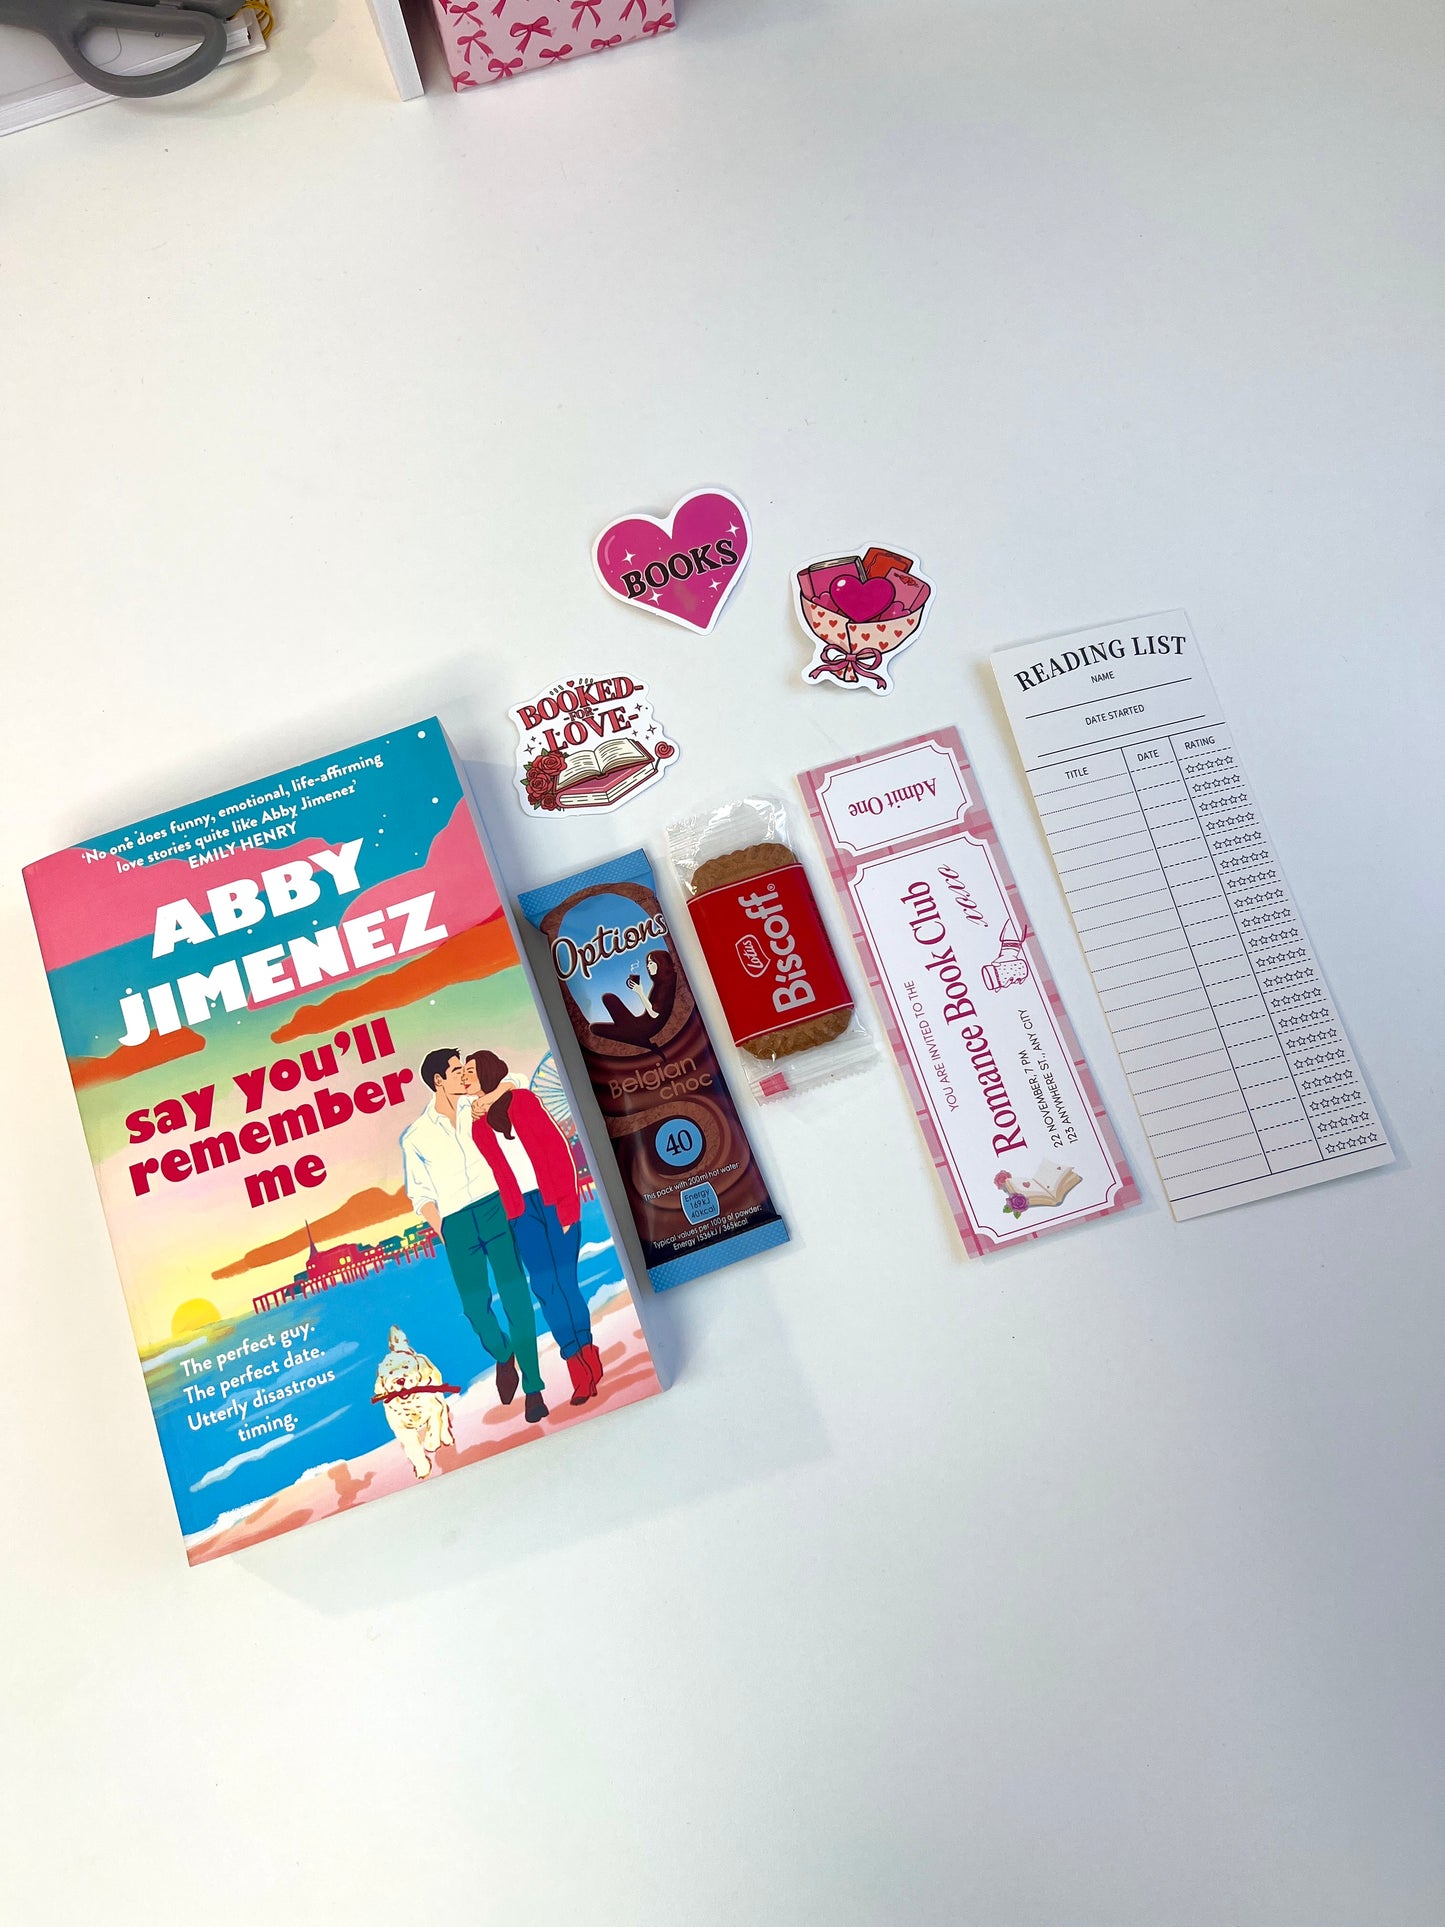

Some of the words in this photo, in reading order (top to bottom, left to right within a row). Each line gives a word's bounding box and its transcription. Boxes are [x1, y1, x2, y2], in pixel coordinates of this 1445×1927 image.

[620, 538, 739, 600] BOOKS
[1013, 639, 1127, 692] READING
[1131, 635, 1187, 657] LIST
[1090, 670, 1115, 684] NAME
[1085, 712, 1107, 726] DATE
[1108, 704, 1145, 721] STARTED
[1137, 749, 1160, 762] DATE
[1184, 735, 1216, 750] RATING
[1064, 767, 1089, 781] TITLE
[110, 841, 134, 857] one
[136, 829, 168, 846] does
[170, 813, 216, 834] funny,
[219, 784, 291, 818] emotional,
[292, 753, 384, 792] life-affirming
[848, 797, 883, 817] One
[884, 778, 937, 809] Admit
[116, 857, 145, 874] love
[147, 841, 192, 864] stories
[195, 828, 230, 850] quite
[232, 818, 258, 835] like
[261, 804, 298, 825] Abby
[188, 842, 236, 869] EMILY
[241, 821, 298, 851] HENRY
[151, 837, 364, 959] ABBY
[900, 881, 947, 946] Club
[551, 913, 670, 981] Options
[118, 891, 448, 1047] JIMENEZ
[924, 945, 978, 1025] Book
[903, 979, 918, 1001] THE
[912, 1002, 925, 1019] TO
[1017, 1009, 1034, 1031] CITY
[920, 1019, 941, 1060] INVITED
[1027, 1032, 1043, 1051] ANY
[937, 1065, 950, 1085] ARE
[1018, 1049, 1032, 1067] PM
[608, 1056, 698, 1100] Belgian
[659, 1073, 713, 1100] choc
[961, 1024, 1028, 1158] Romance
[125, 1084, 215, 1144] say
[945, 1086, 960, 1112] YOU
[1028, 1073, 1056, 1132] NOVEMBER,
[1045, 1070, 1072, 1125] ANYWHERE
[128, 1068, 414, 1197] remember
[665, 1129, 693, 1156] 40
[1051, 1134, 1064, 1149] 22
[244, 1154, 327, 1208] me
[656, 1186, 674, 1198] pack
[674, 1181, 688, 1192] with
[708, 1169, 720, 1179] hot
[684, 1188, 710, 1203] Energy
[653, 1235, 676, 1249] Typical
[677, 1228, 698, 1240] values
[699, 1223, 710, 1233] per
[727, 1214, 735, 1222] of
[673, 1238, 697, 1251] Energy
[180, 1359, 212, 1377] The
[216, 1334, 276, 1371] perfect
[280, 1322, 316, 1348] guy.
[183, 1384, 216, 1404] The
[220, 1360, 280, 1398] perfect
[283, 1347, 326, 1369] date.
[187, 1399, 249, 1431] Utterly
[252, 1370, 336, 1409] disastrous
[237, 1412, 299, 1442] timing.
